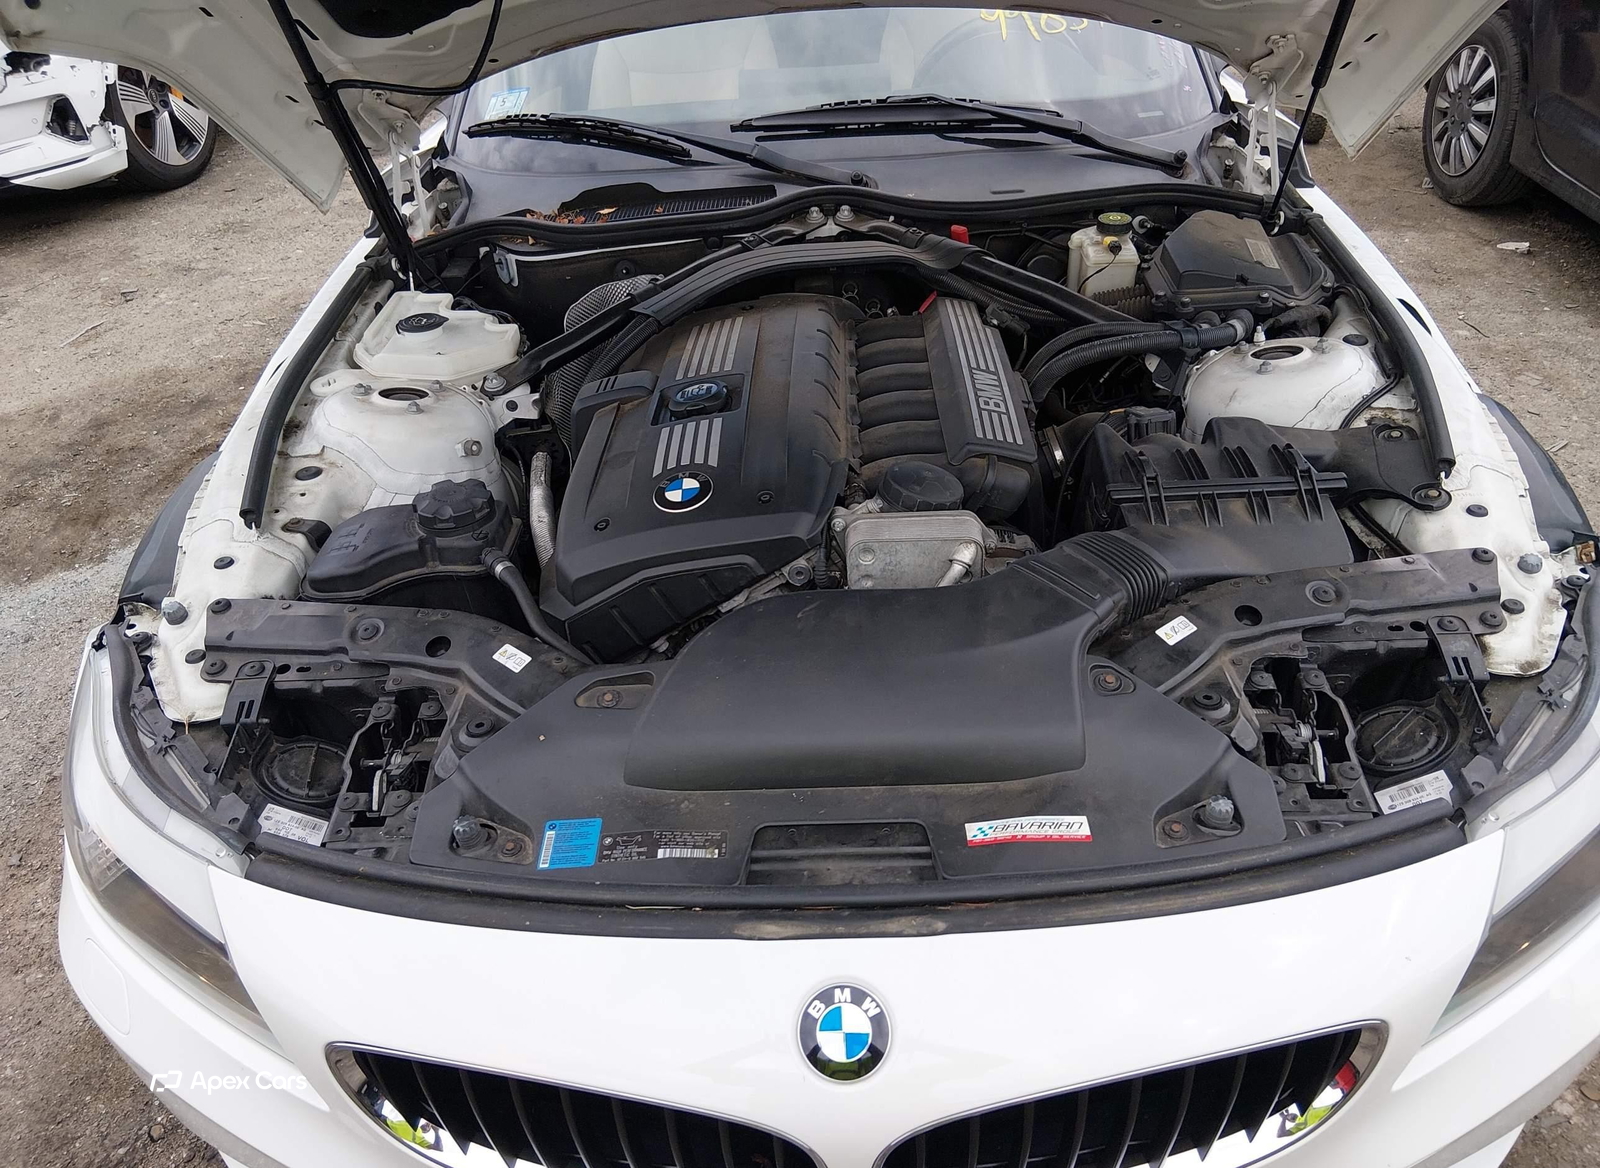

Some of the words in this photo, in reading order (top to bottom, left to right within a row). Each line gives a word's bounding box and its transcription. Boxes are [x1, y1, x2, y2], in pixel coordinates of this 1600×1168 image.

[971, 368, 1007, 414] BMW
[659, 472, 709, 488] BMW
[992, 821, 1084, 833] BAVARIAN
[807, 987, 881, 1020] BMW
